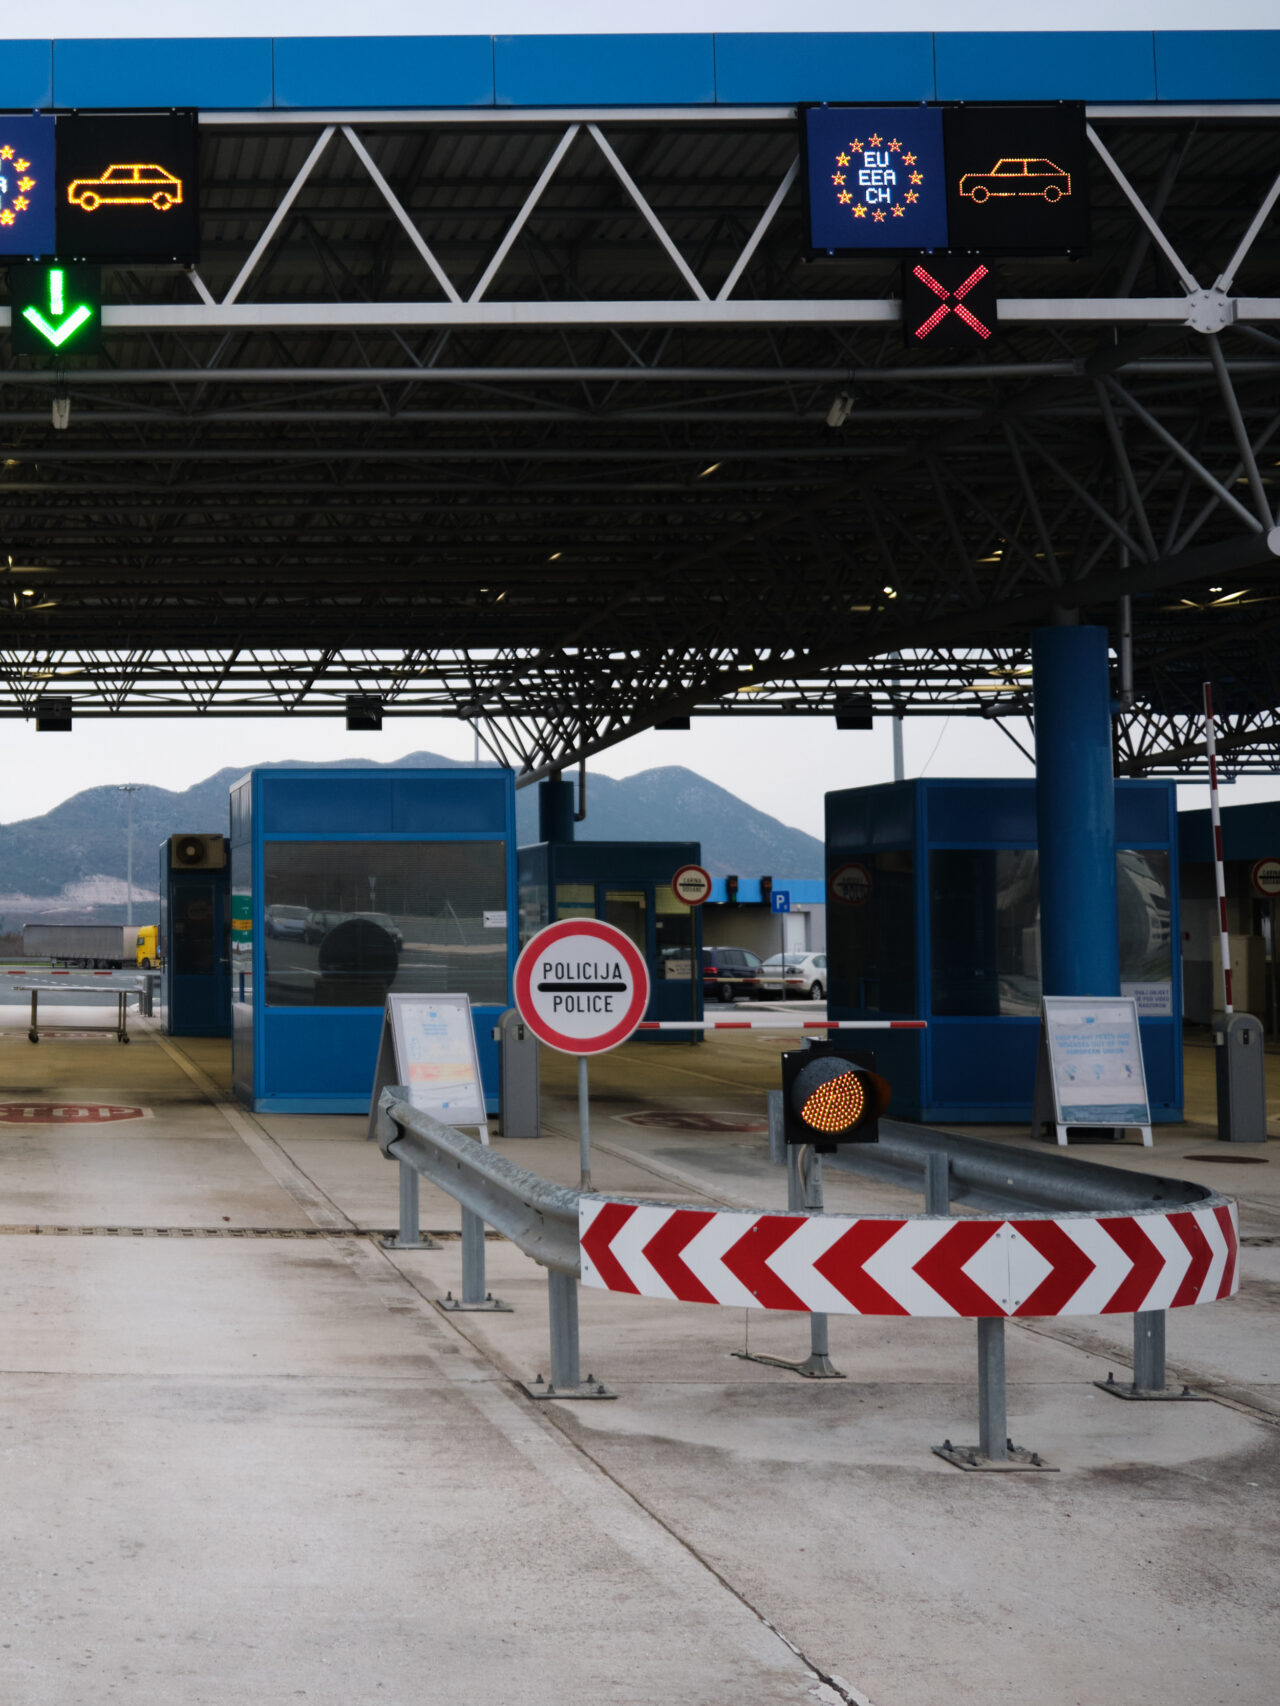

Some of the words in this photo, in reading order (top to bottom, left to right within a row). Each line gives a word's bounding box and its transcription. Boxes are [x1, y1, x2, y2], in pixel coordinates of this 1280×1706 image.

[864, 151, 889, 167] EU
[858, 170, 896, 186] EEA
[865, 188, 891, 204] CH
[776, 895, 785, 909] P
[543, 962, 622, 980] POLICIJA
[553, 995, 614, 1013] POLICE
